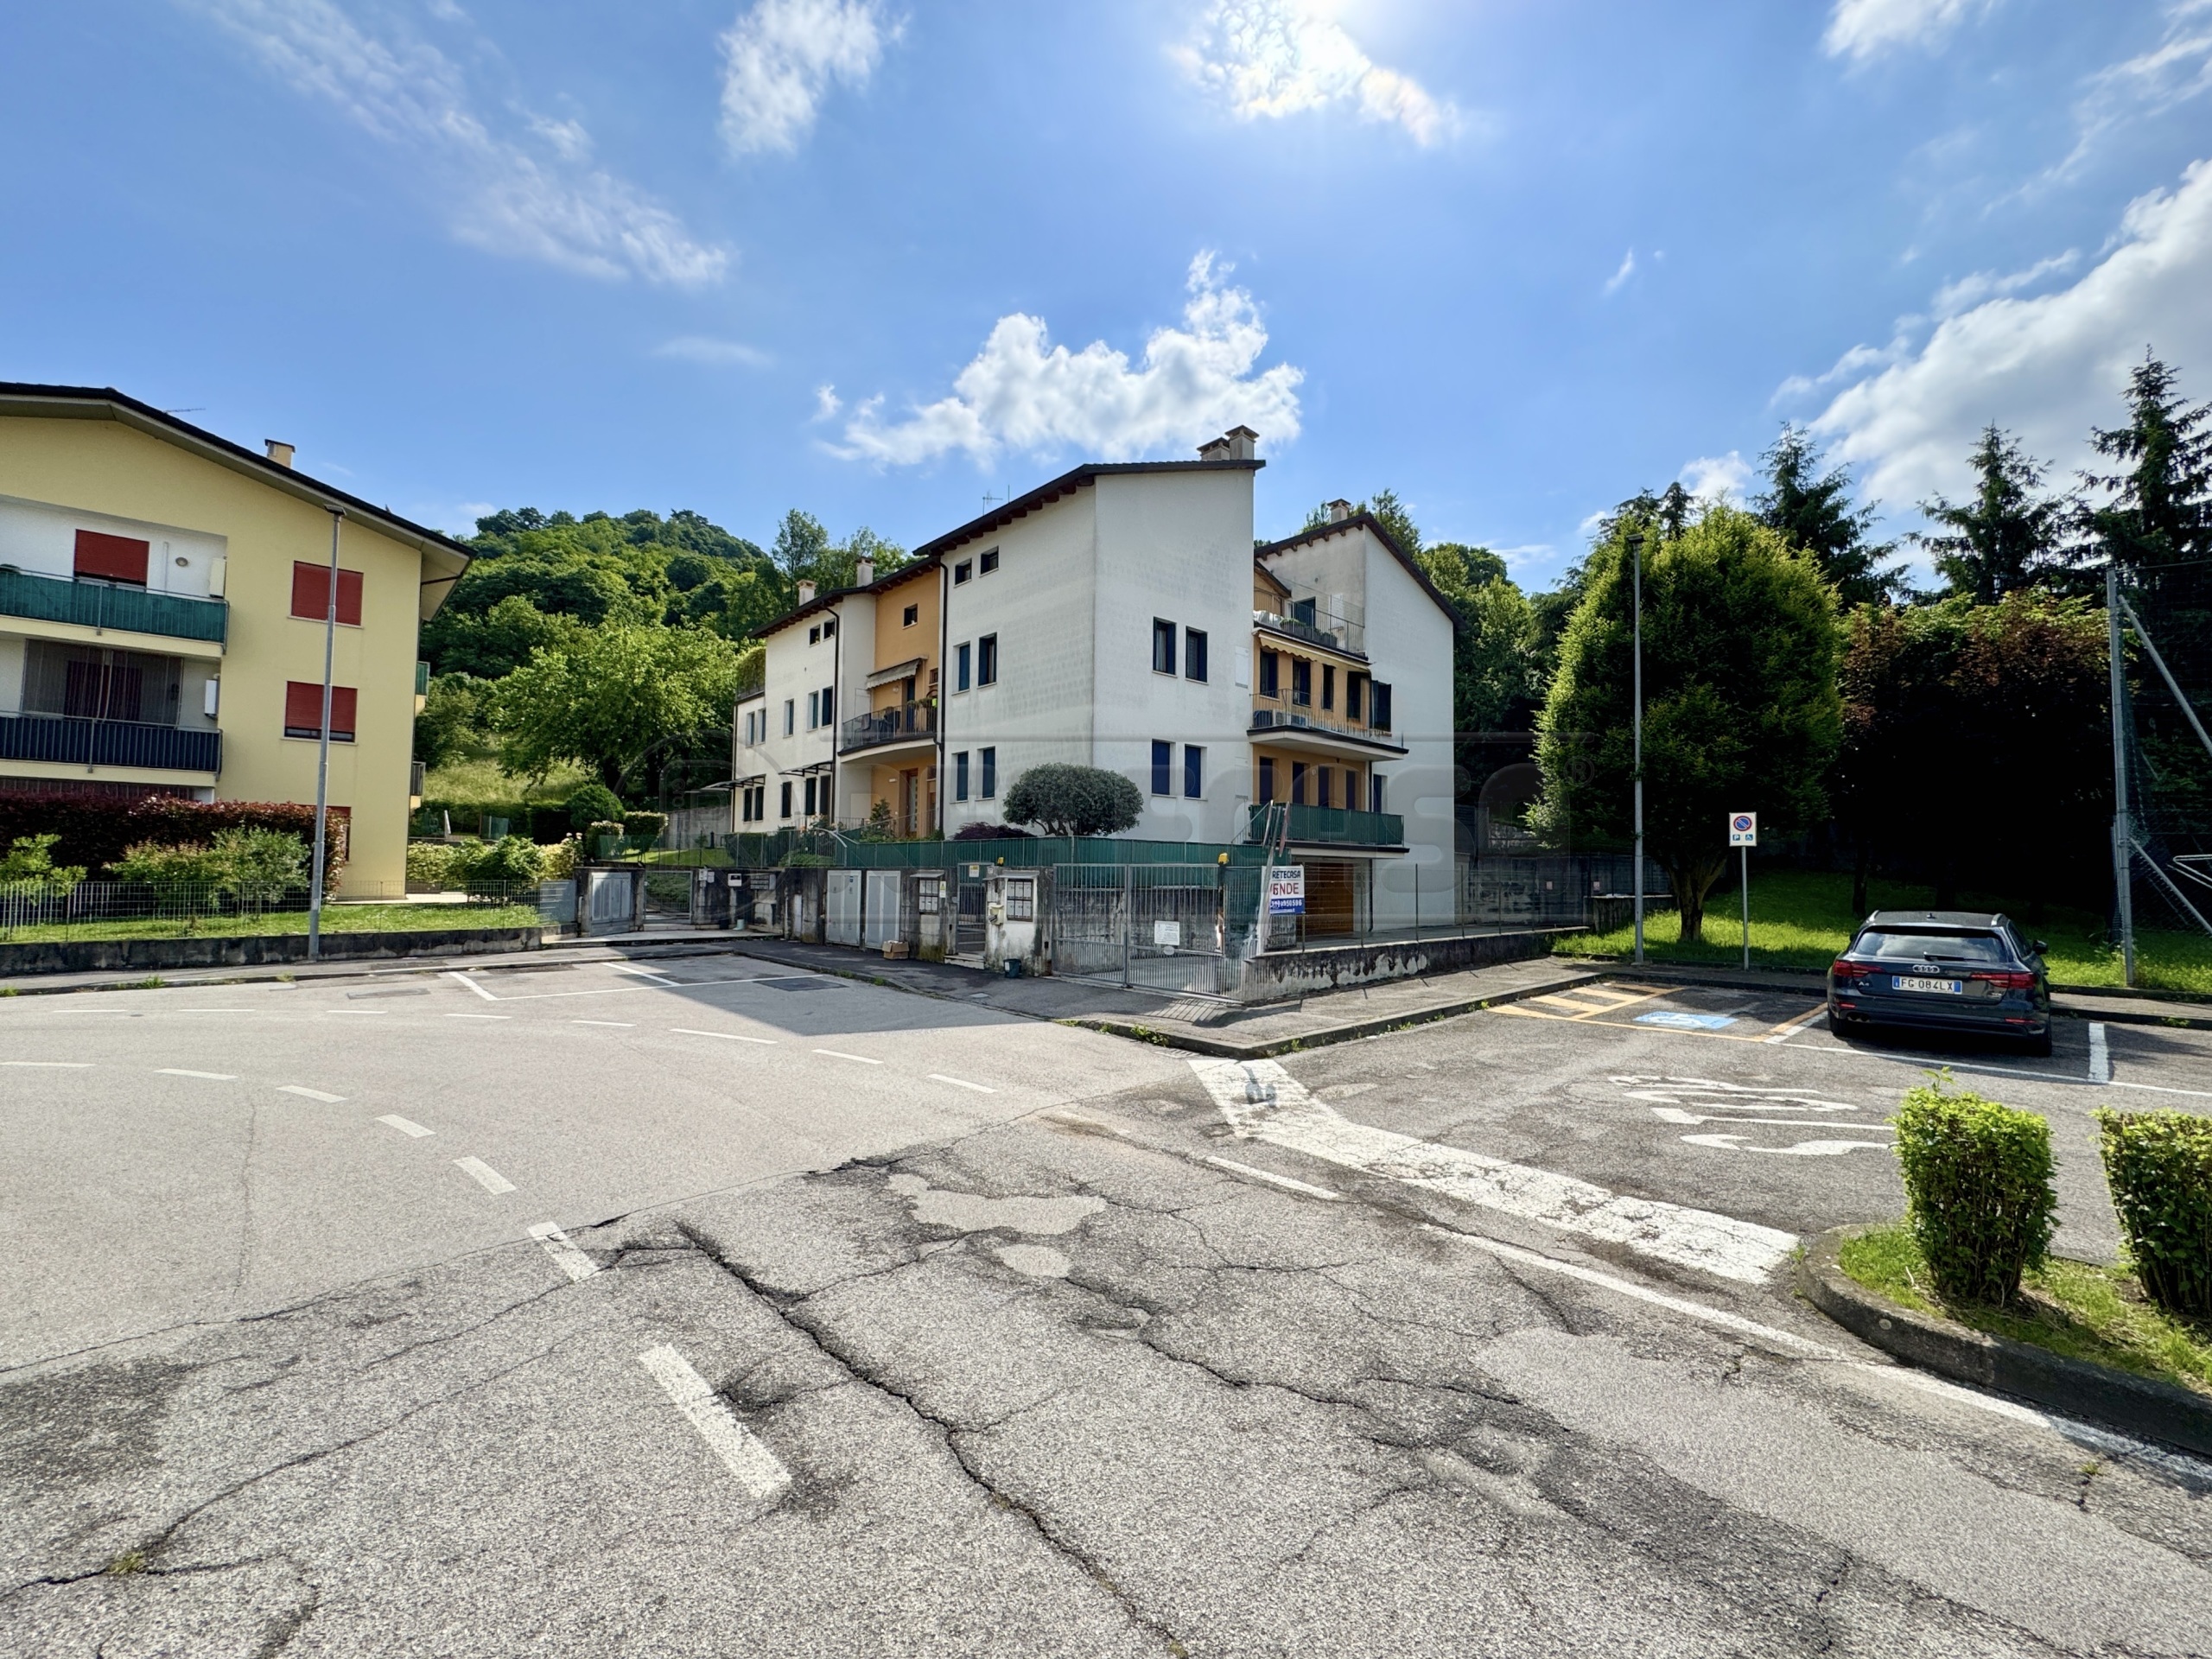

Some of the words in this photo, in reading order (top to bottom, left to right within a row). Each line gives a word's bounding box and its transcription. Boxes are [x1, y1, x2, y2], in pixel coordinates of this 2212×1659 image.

[1272, 870, 1301, 879] RETECASA
[1901, 978, 1915, 988] FG
[1918, 980, 1953, 991] 084LX
